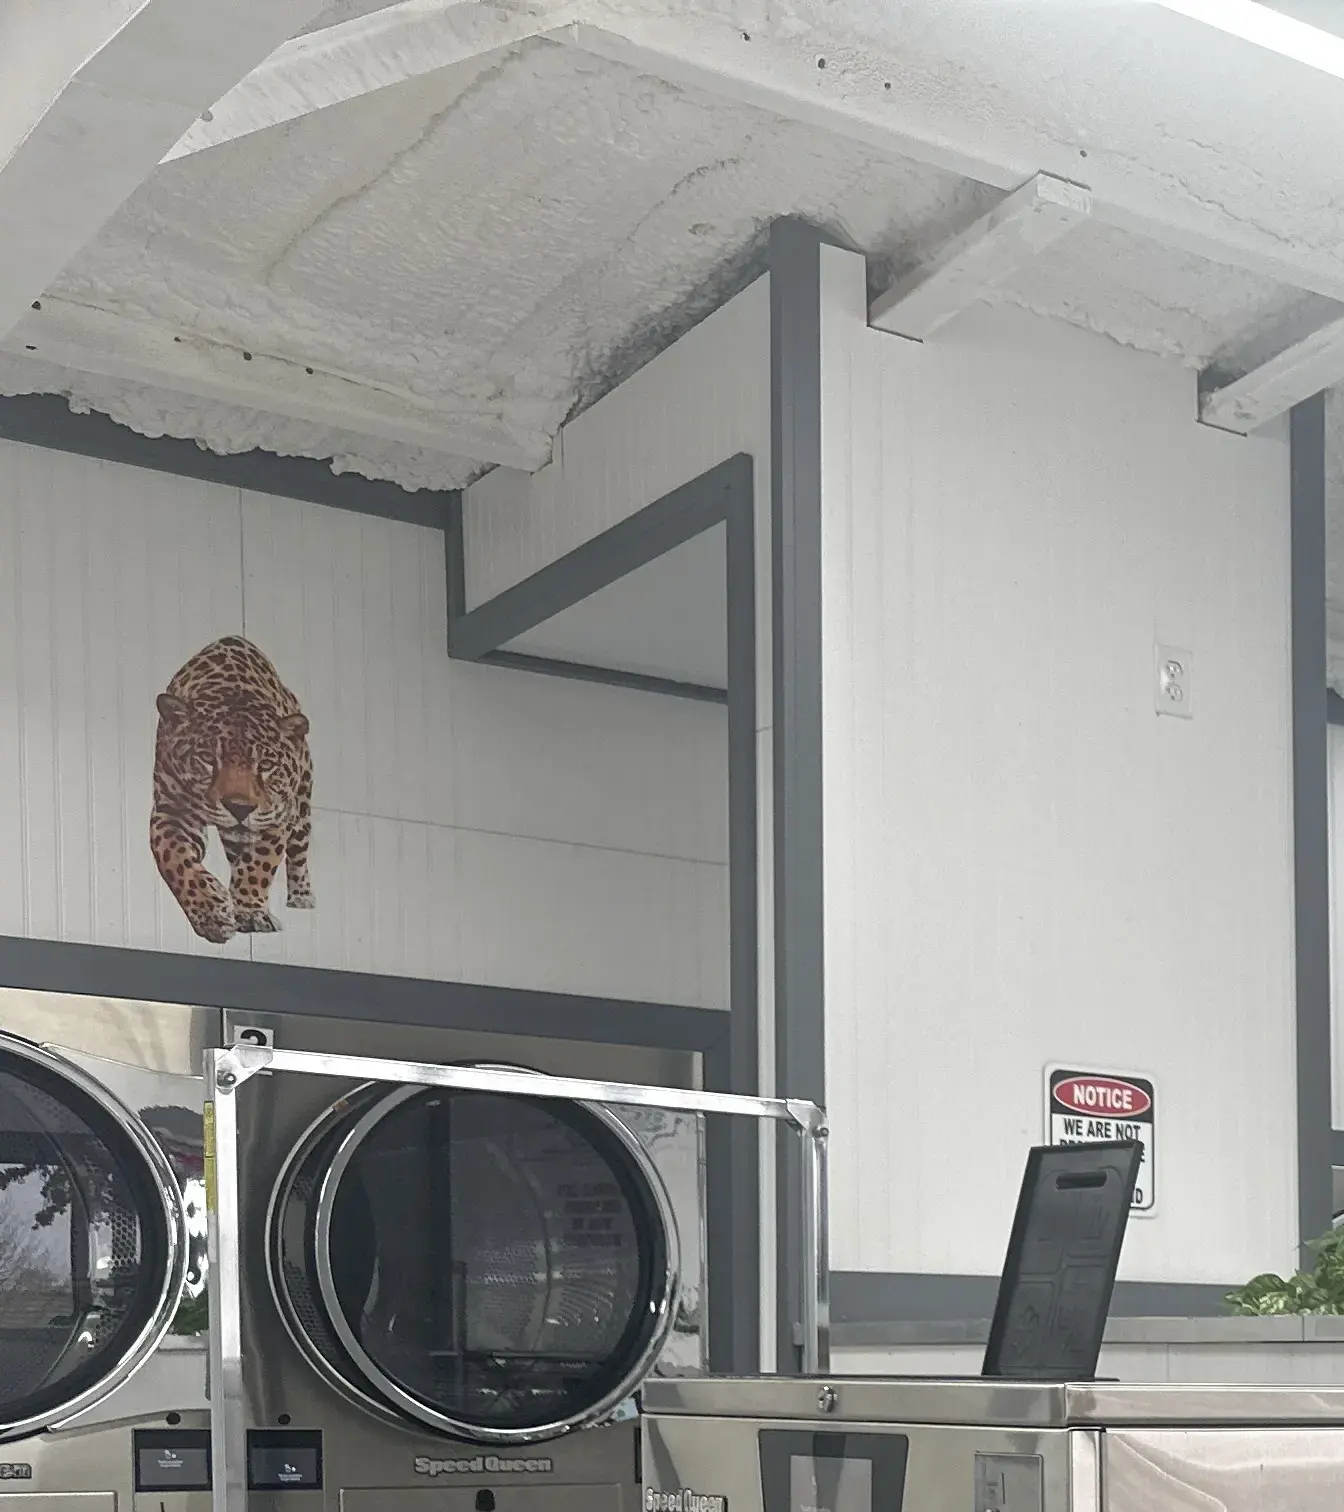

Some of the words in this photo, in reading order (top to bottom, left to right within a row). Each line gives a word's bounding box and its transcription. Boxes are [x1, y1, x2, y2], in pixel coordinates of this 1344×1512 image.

[1073, 1084, 1133, 1110] NOTICE
[1064, 1118, 1083, 1136] WE
[1087, 1121, 1112, 1138] ARE
[1116, 1125, 1141, 1141] NOT
[414, 1455, 484, 1477] Speed
[485, 1455, 552, 1473] Queen
